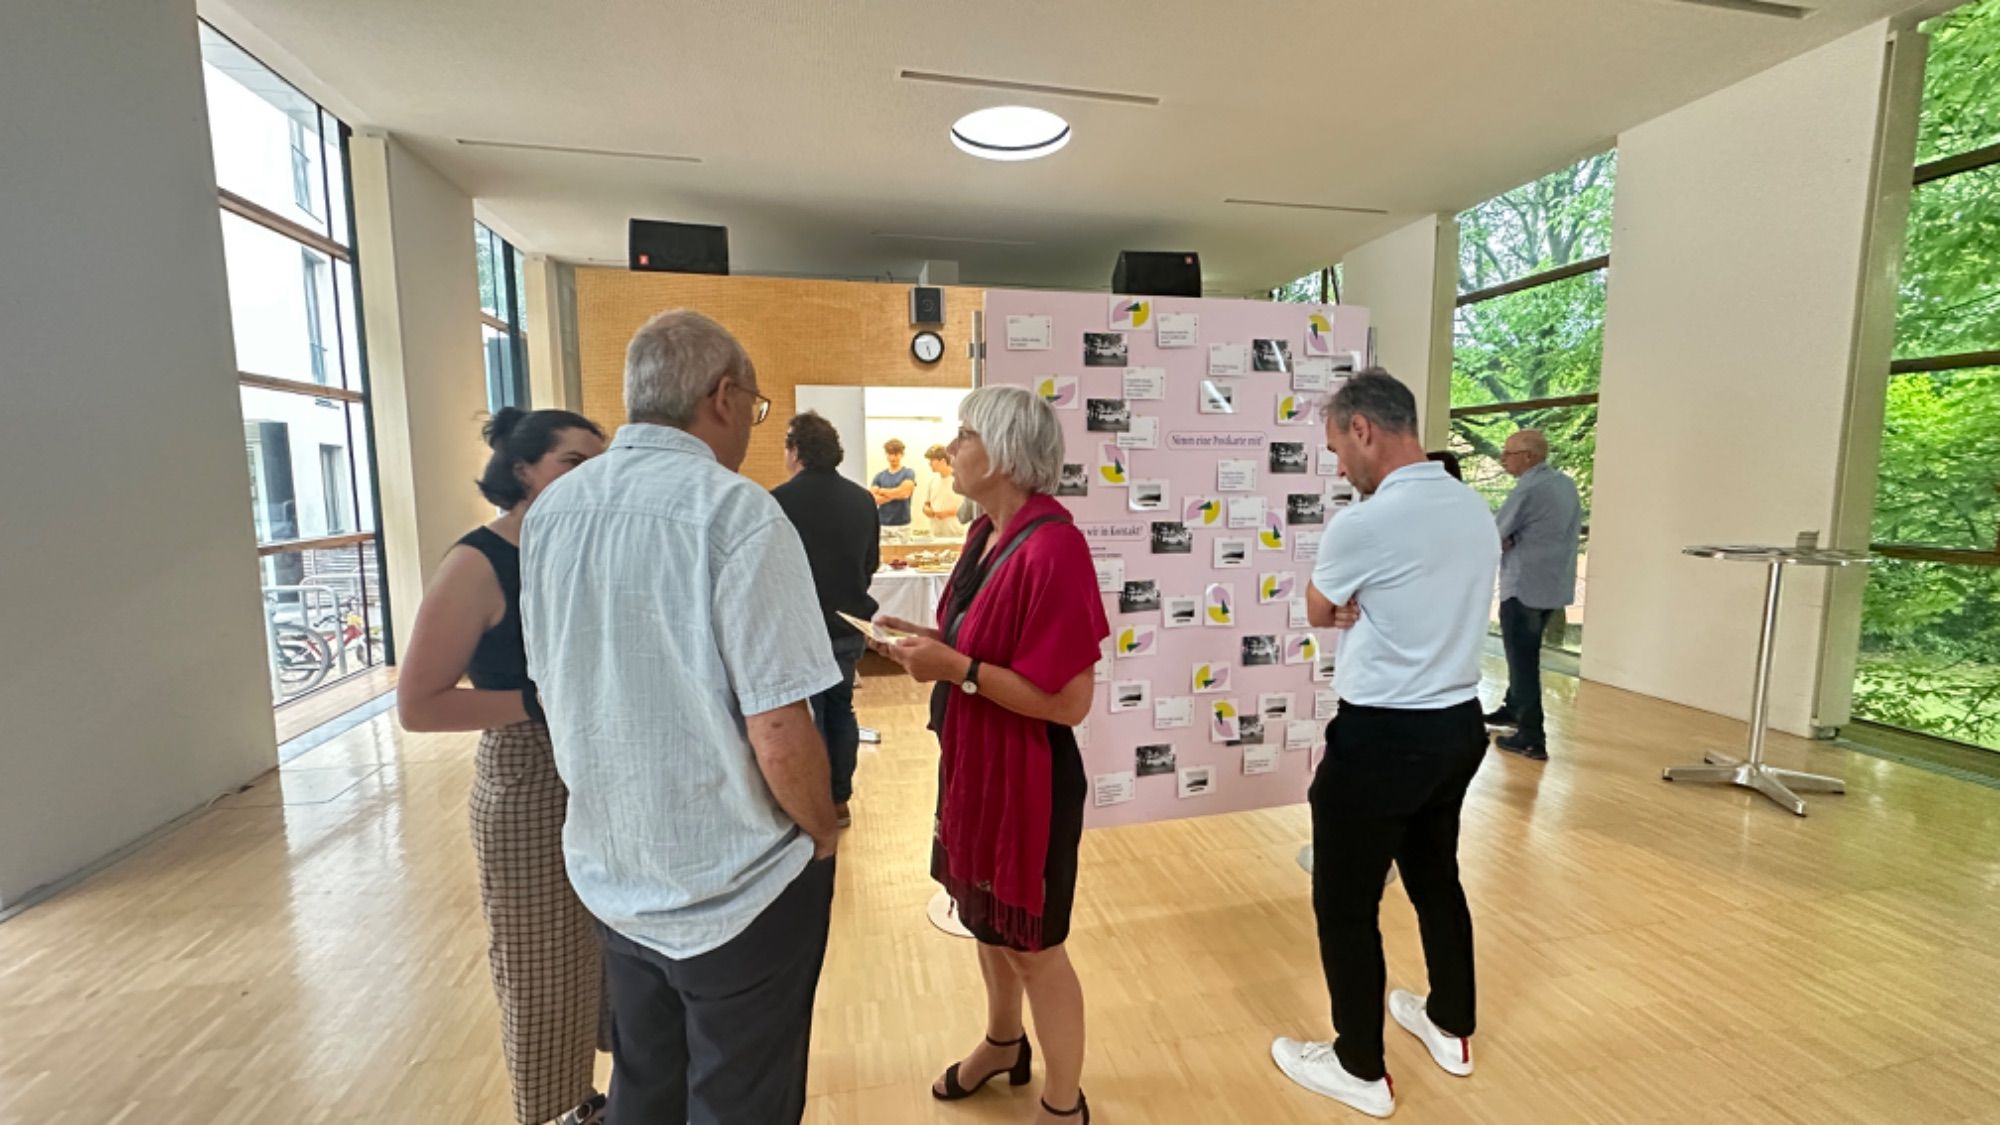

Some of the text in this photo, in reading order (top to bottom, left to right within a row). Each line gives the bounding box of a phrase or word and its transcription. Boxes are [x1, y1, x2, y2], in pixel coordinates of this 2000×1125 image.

[1196, 435, 1212, 445] eine
[1213, 434, 1247, 445] Postkarte
[1087, 526, 1098, 536] wir
[1101, 526, 1108, 536] in
